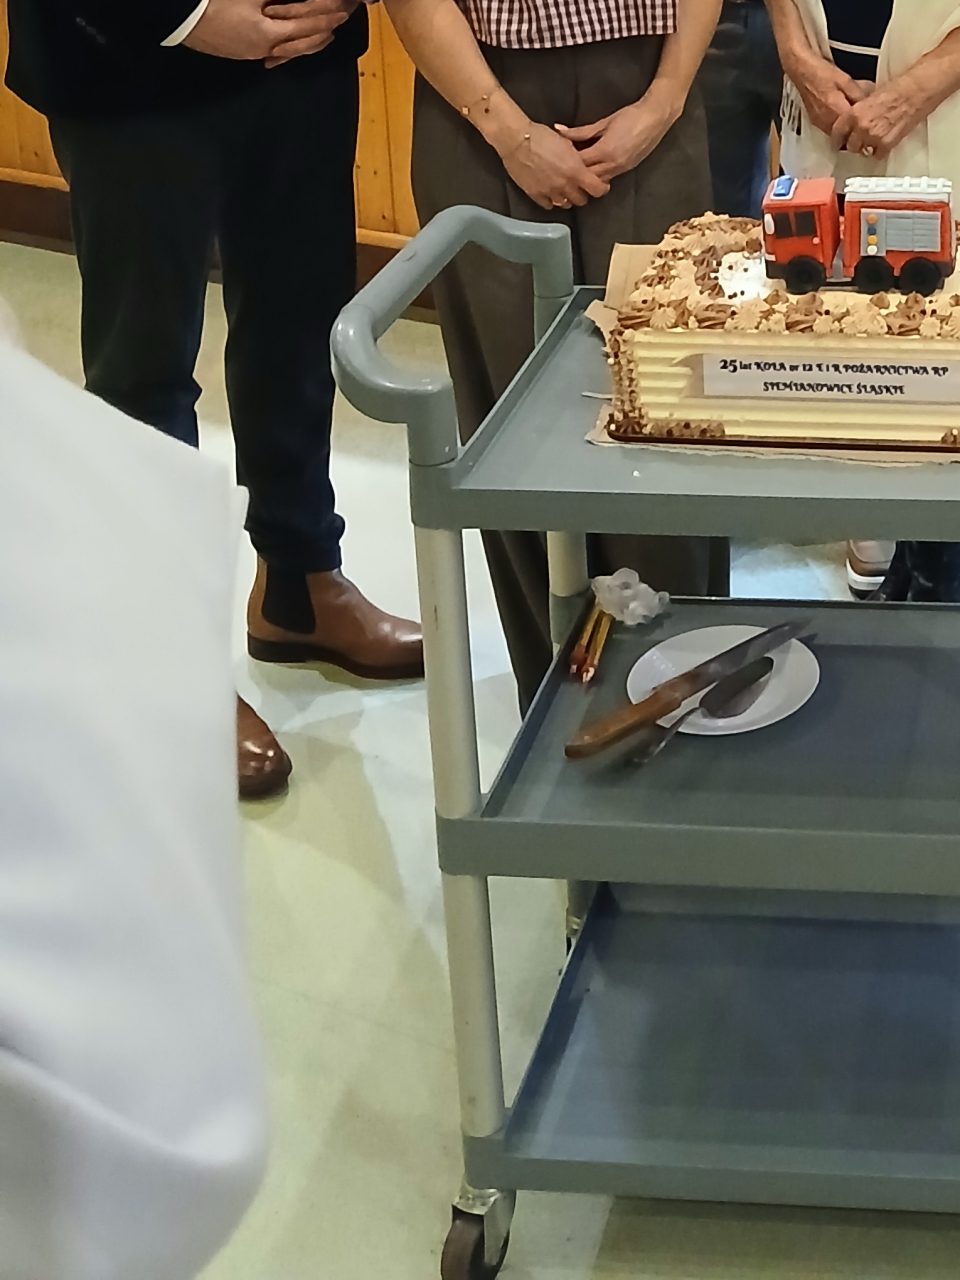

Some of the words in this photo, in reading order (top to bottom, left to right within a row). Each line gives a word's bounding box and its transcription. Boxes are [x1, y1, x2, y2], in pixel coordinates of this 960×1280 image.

[719, 359, 738, 374] 25
[802, 363, 813, 372] 12
[930, 366, 949, 377] RP
